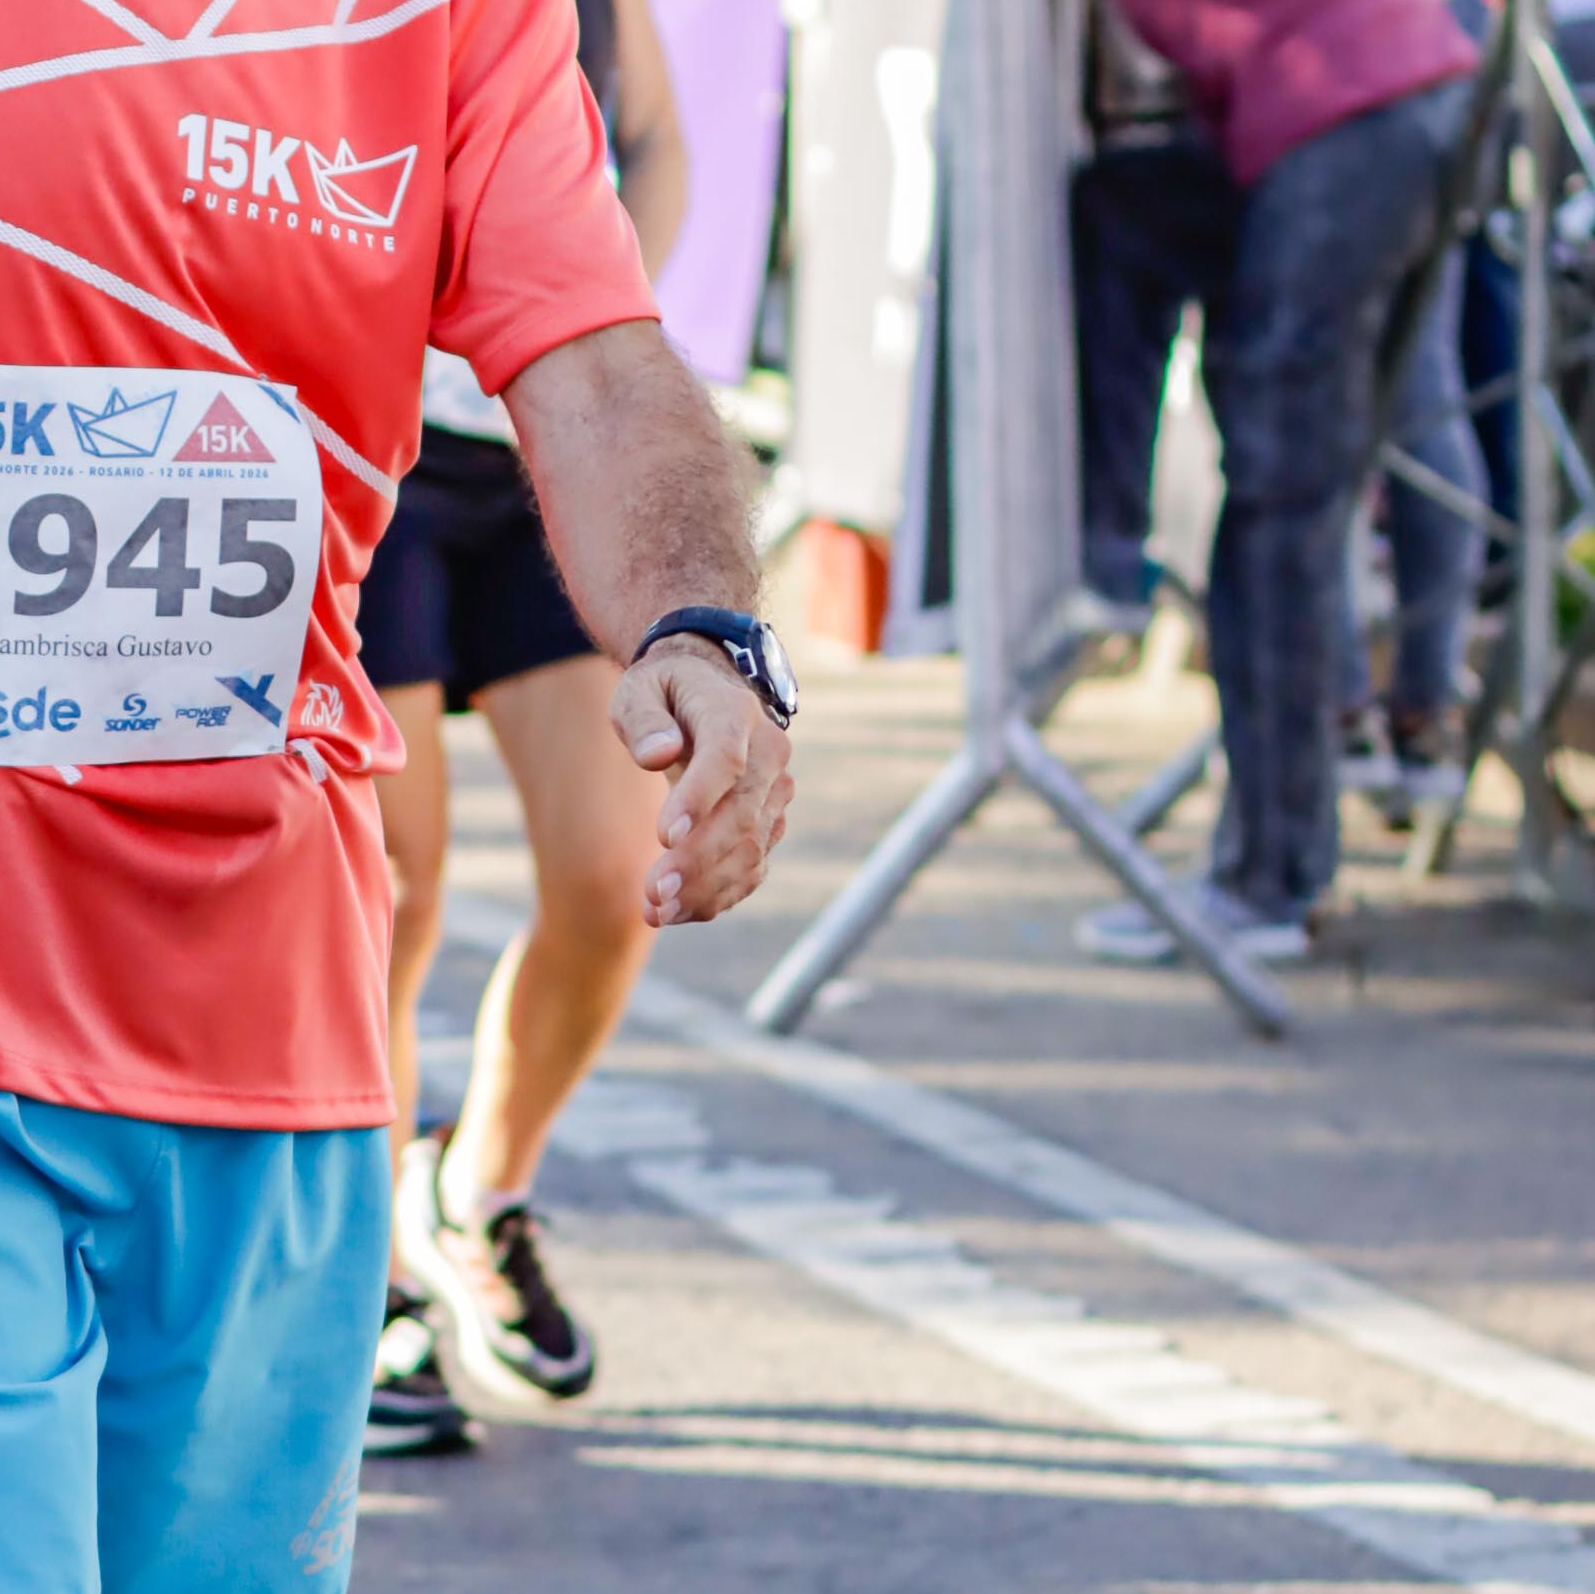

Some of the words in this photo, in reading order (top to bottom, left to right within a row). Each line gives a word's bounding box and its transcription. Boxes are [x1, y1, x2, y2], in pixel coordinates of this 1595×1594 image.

[178, 113, 301, 205] 15K
[181, 188, 299, 230] PUERTO
[310, 217, 396, 253] NORTE
[196, 424, 253, 454] 15K
[43, 465, 74, 477] 2026
[89, 467, 144, 478] ROSARIO
[160, 468, 173, 478] 12
[178, 468, 194, 478] DE
[199, 468, 235, 478] ABRIL
[117, 634, 213, 658] Gustavo
